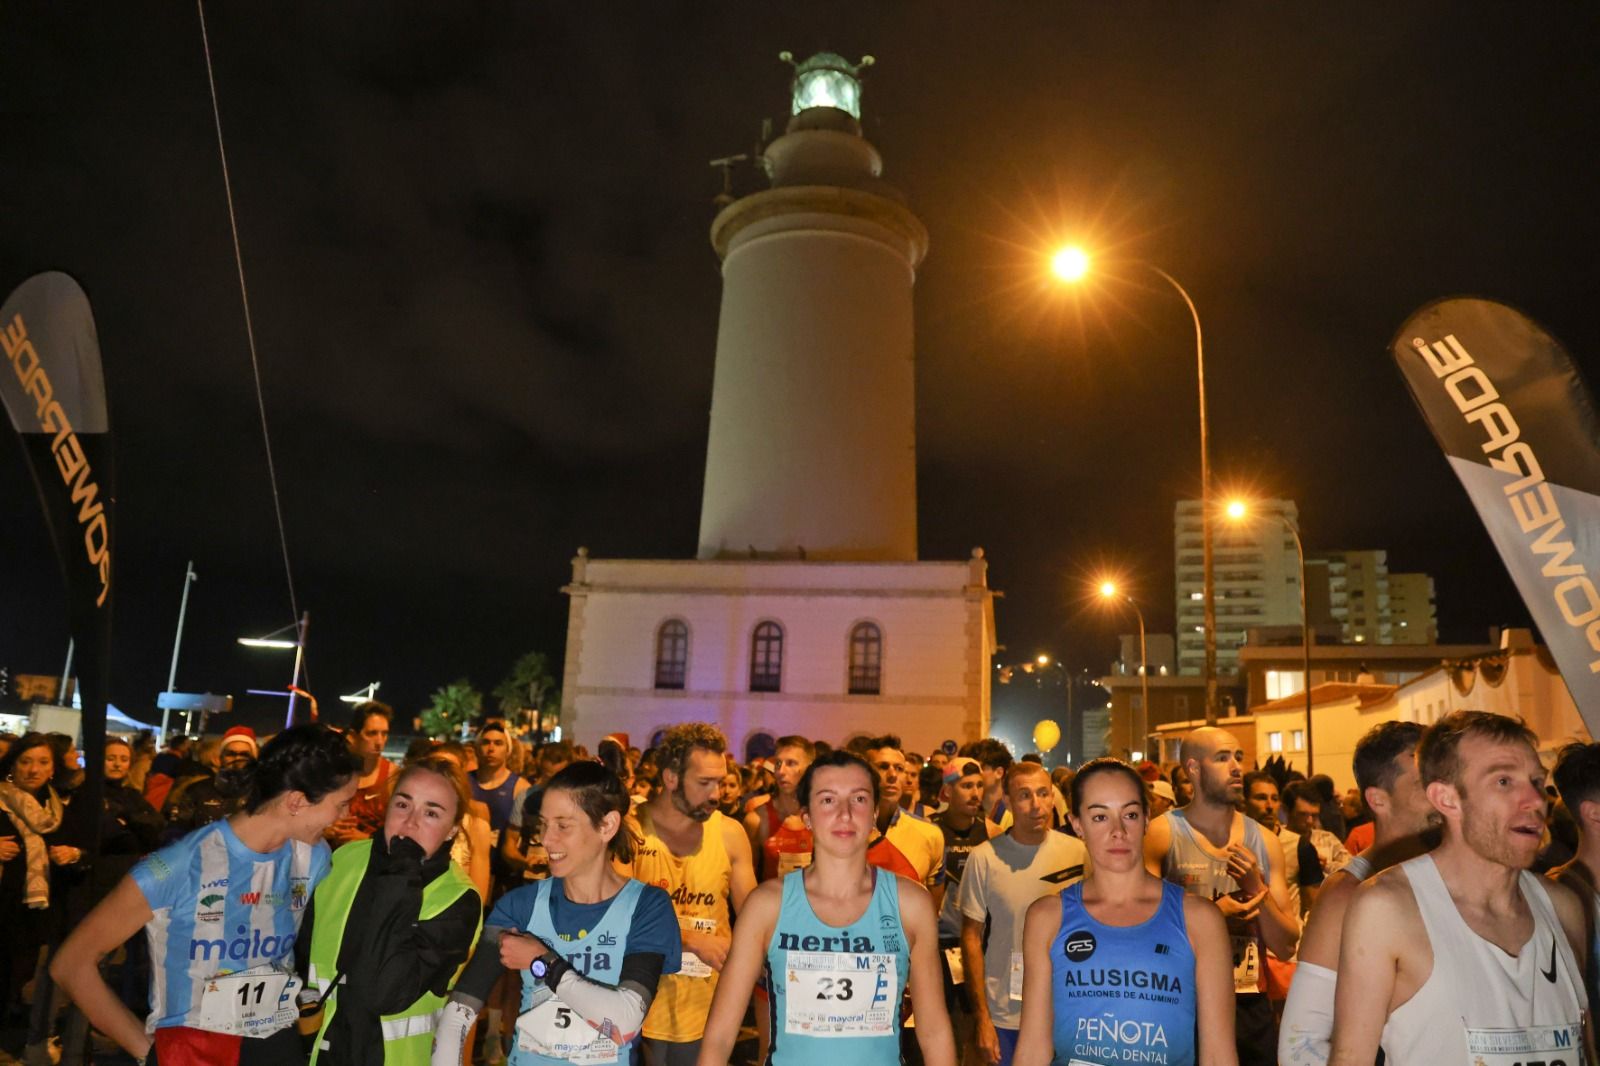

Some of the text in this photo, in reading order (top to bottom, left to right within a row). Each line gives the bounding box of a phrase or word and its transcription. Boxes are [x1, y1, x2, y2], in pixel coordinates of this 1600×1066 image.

[189, 925, 297, 961] málag
[565, 946, 612, 976] rja
[816, 977, 853, 1001] 23
[1065, 969, 1182, 993] ALUSIGMA
[238, 981, 266, 1006] 11
[1068, 990, 1180, 1005] ALEACIONES DE ALUMINIO
[244, 1015, 275, 1029] mayoral
[554, 1007, 571, 1029] 5
[828, 1013, 864, 1024] mayoral
[1075, 1012, 1168, 1048] PEÑOTA
[1074, 1042, 1168, 1065] CLÍNICA DENTAL
